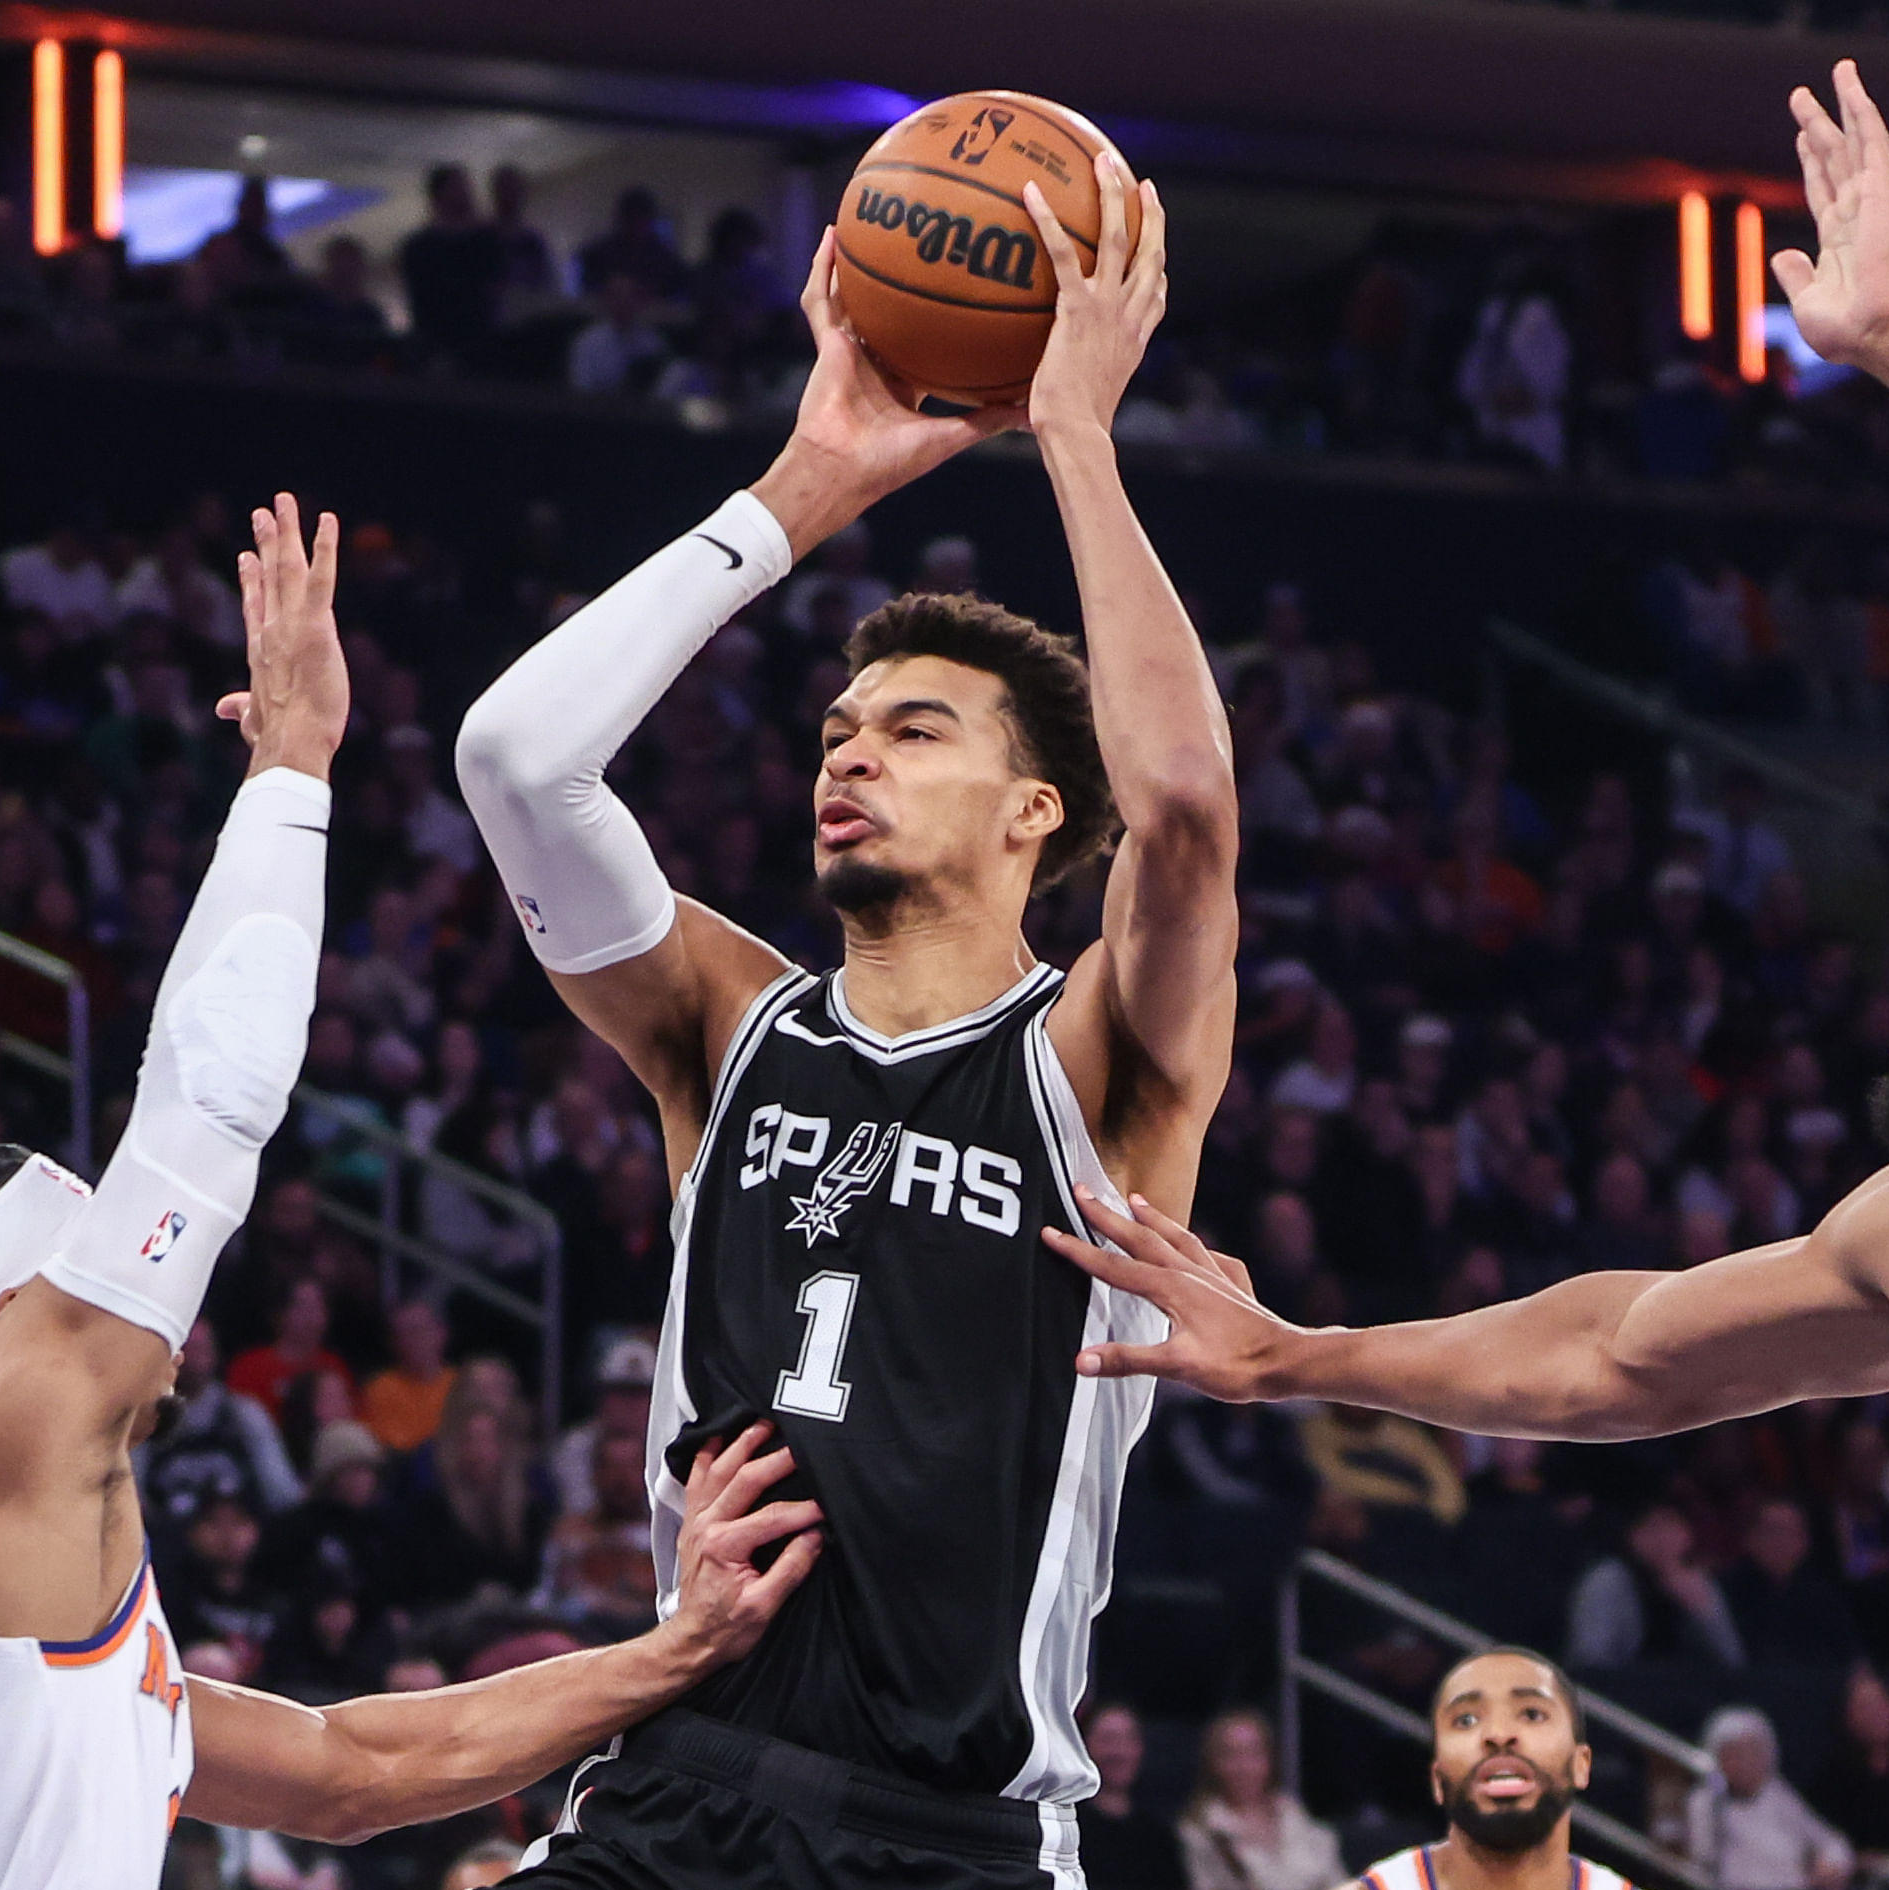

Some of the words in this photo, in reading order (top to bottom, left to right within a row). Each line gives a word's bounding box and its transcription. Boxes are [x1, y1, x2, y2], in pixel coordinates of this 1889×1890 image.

[855, 186, 1037, 291] Wilson
[740, 1103, 1022, 1248] SPURS
[772, 1269, 860, 1423] 1
